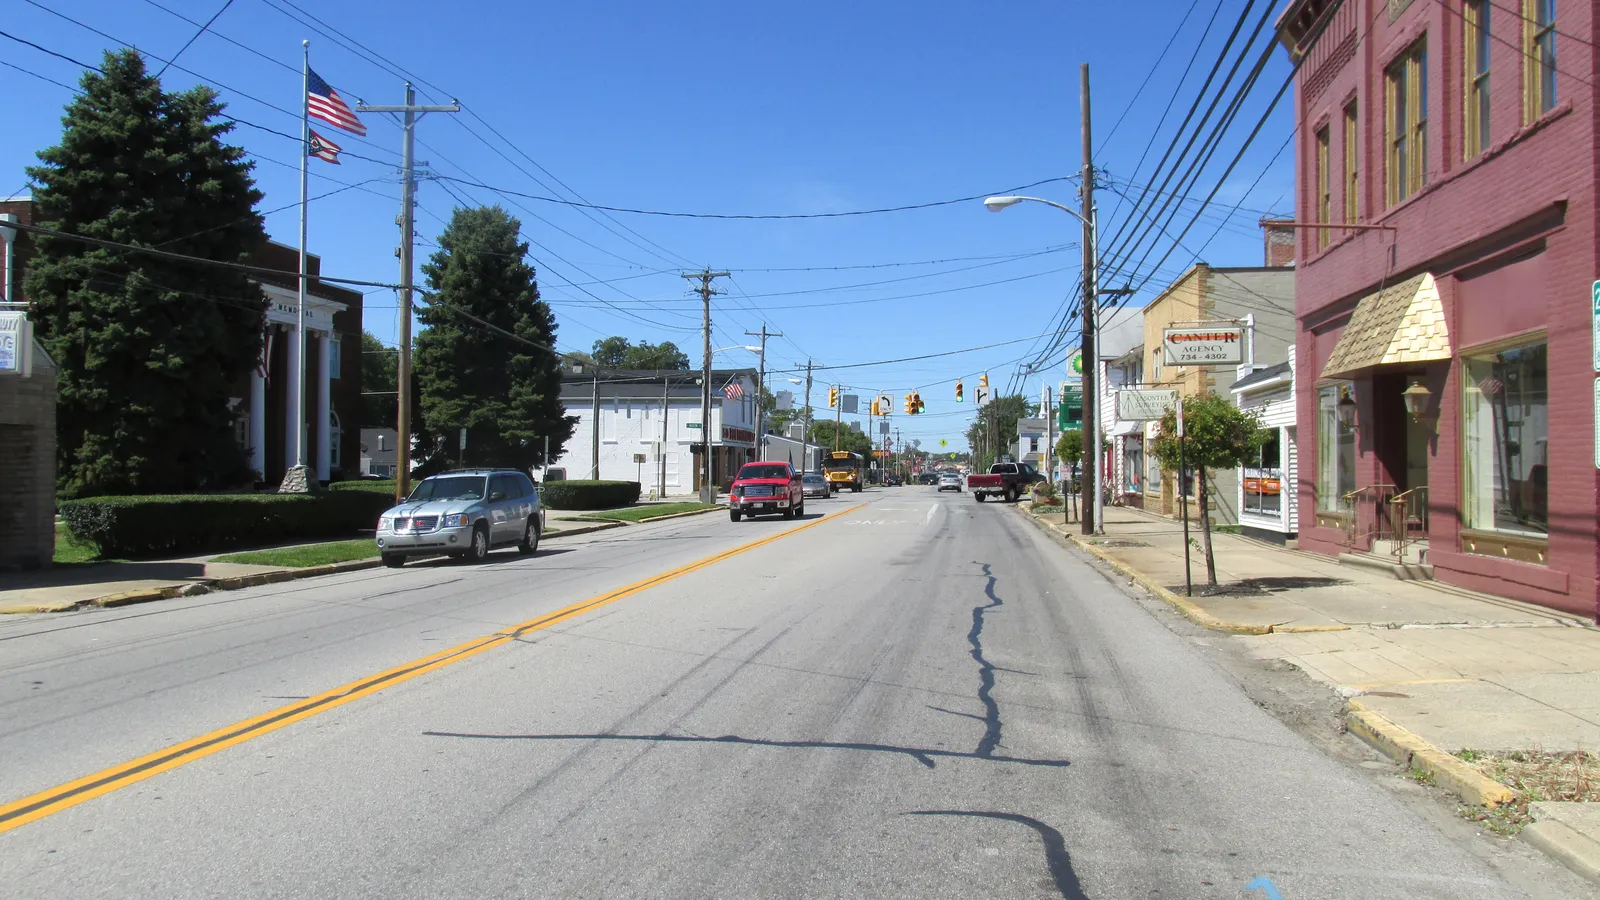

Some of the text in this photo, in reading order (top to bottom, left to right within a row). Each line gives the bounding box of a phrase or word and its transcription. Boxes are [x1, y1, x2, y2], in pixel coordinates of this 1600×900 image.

[278, 303, 314, 318] MEMOAL
[1171, 332, 1236, 345] CANTER
[1182, 345, 1224, 353] AGENCY
